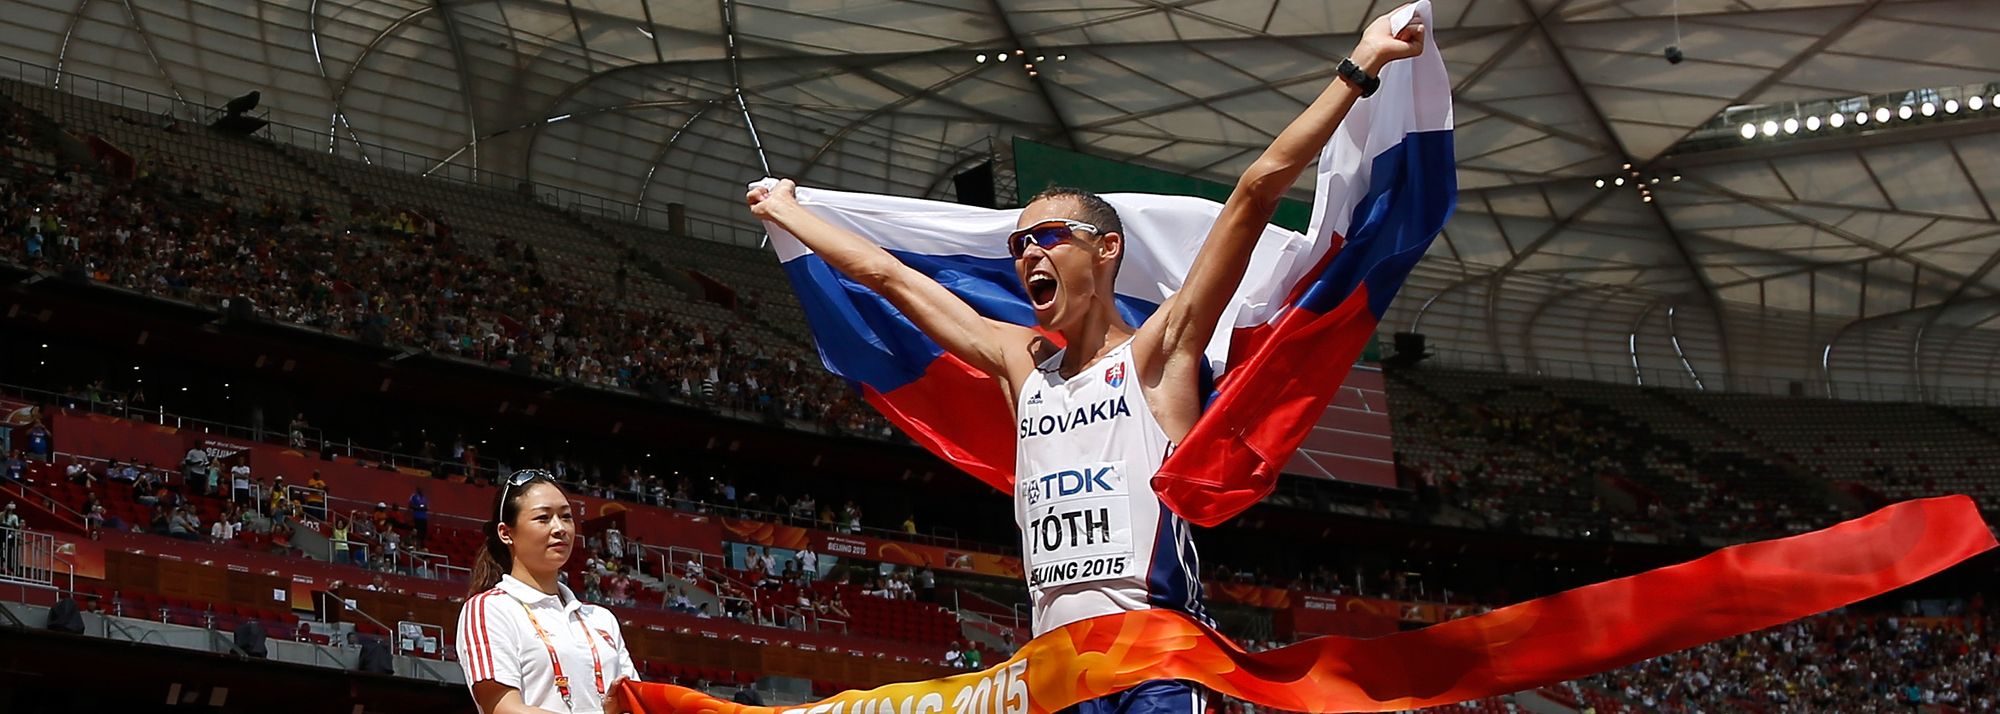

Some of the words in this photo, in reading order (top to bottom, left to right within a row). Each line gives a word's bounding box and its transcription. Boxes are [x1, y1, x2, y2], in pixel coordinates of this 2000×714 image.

[1020, 396, 1131, 439] SLOVAKIA
[1040, 467, 1114, 499] TDK
[1031, 506, 1110, 554] TÓTH
[1082, 557, 1125, 577] 2015
[952, 658, 1029, 714] 2015
